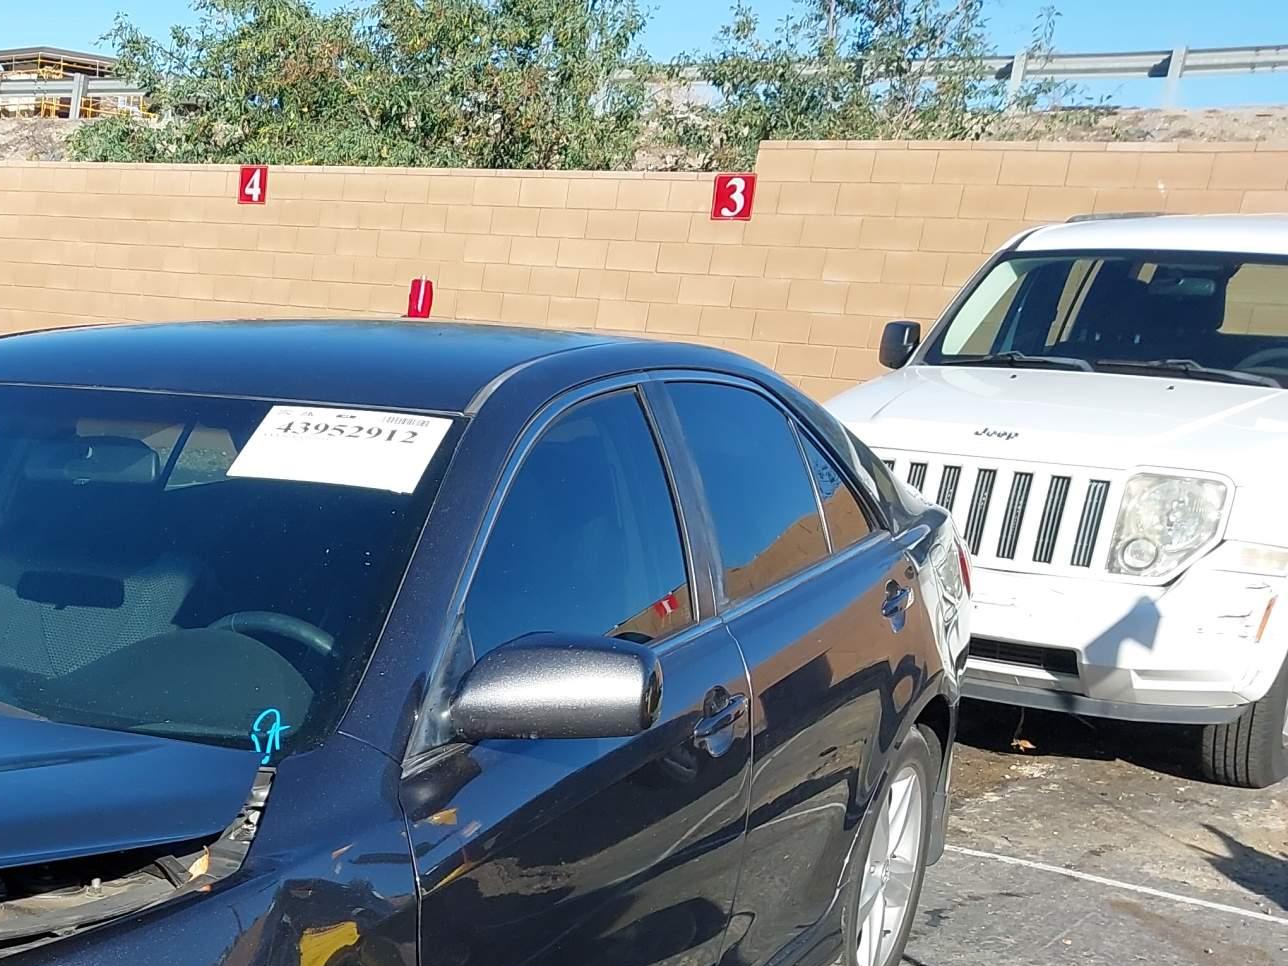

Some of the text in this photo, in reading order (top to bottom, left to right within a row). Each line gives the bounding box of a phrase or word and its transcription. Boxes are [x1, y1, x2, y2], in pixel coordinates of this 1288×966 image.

[244, 168, 262, 202] 4
[720, 177, 746, 217] 3
[275, 421, 418, 444] 43952912
[973, 427, 1019, 441] Jeep
